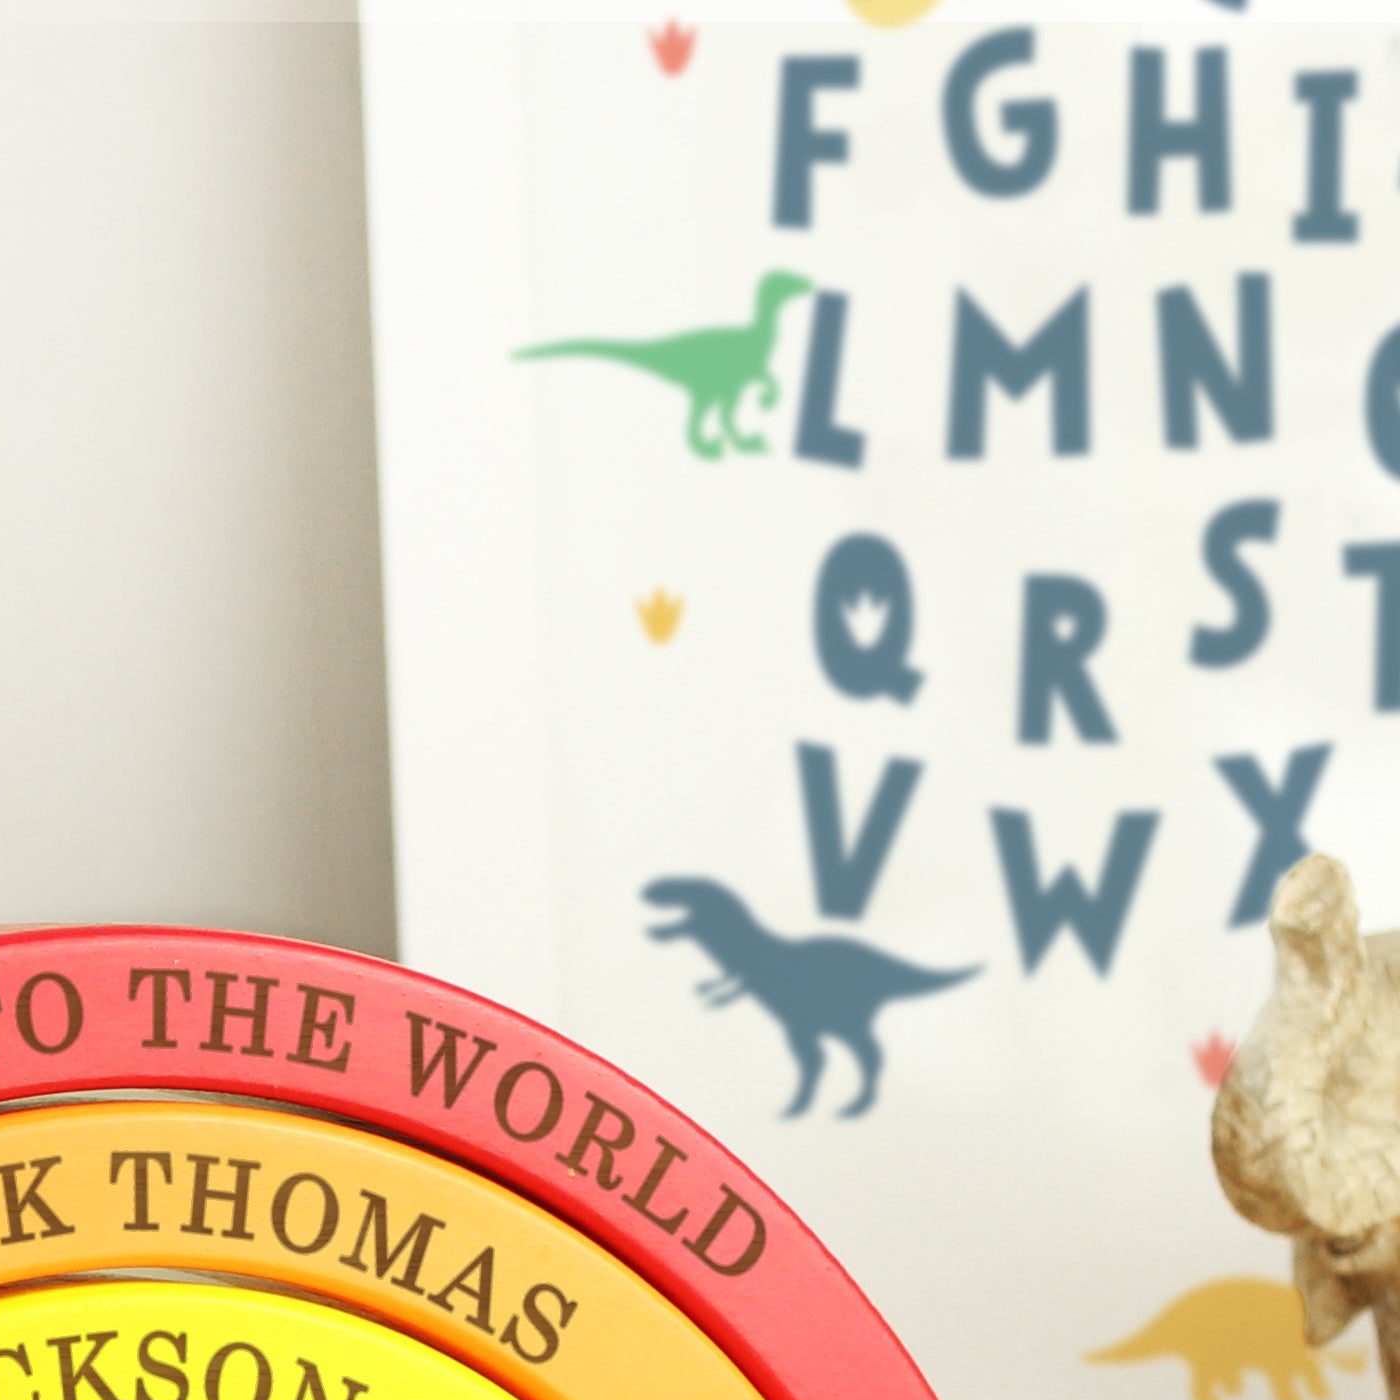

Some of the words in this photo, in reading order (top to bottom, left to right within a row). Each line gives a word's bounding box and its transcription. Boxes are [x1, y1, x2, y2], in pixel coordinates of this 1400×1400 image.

[773, 56, 859, 229] F
[942, 28, 1058, 198] G
[1128, 47, 1231, 215] H
[1293, 70, 1358, 243] I
[795, 291, 864, 468] L
[947, 289, 1090, 459] M
[1157, 272, 1273, 450] N
[814, 534, 922, 704] Q
[1018, 574, 1116, 745] R
[1190, 499, 1279, 668] S
[797, 743, 922, 921] V
[991, 808, 1159, 974] W
[1212, 741, 1333, 930] X
[128, 968, 356, 1073] THE
[404, 1011, 768, 1277] WORLD
[109, 1151, 578, 1365] THOMAS
